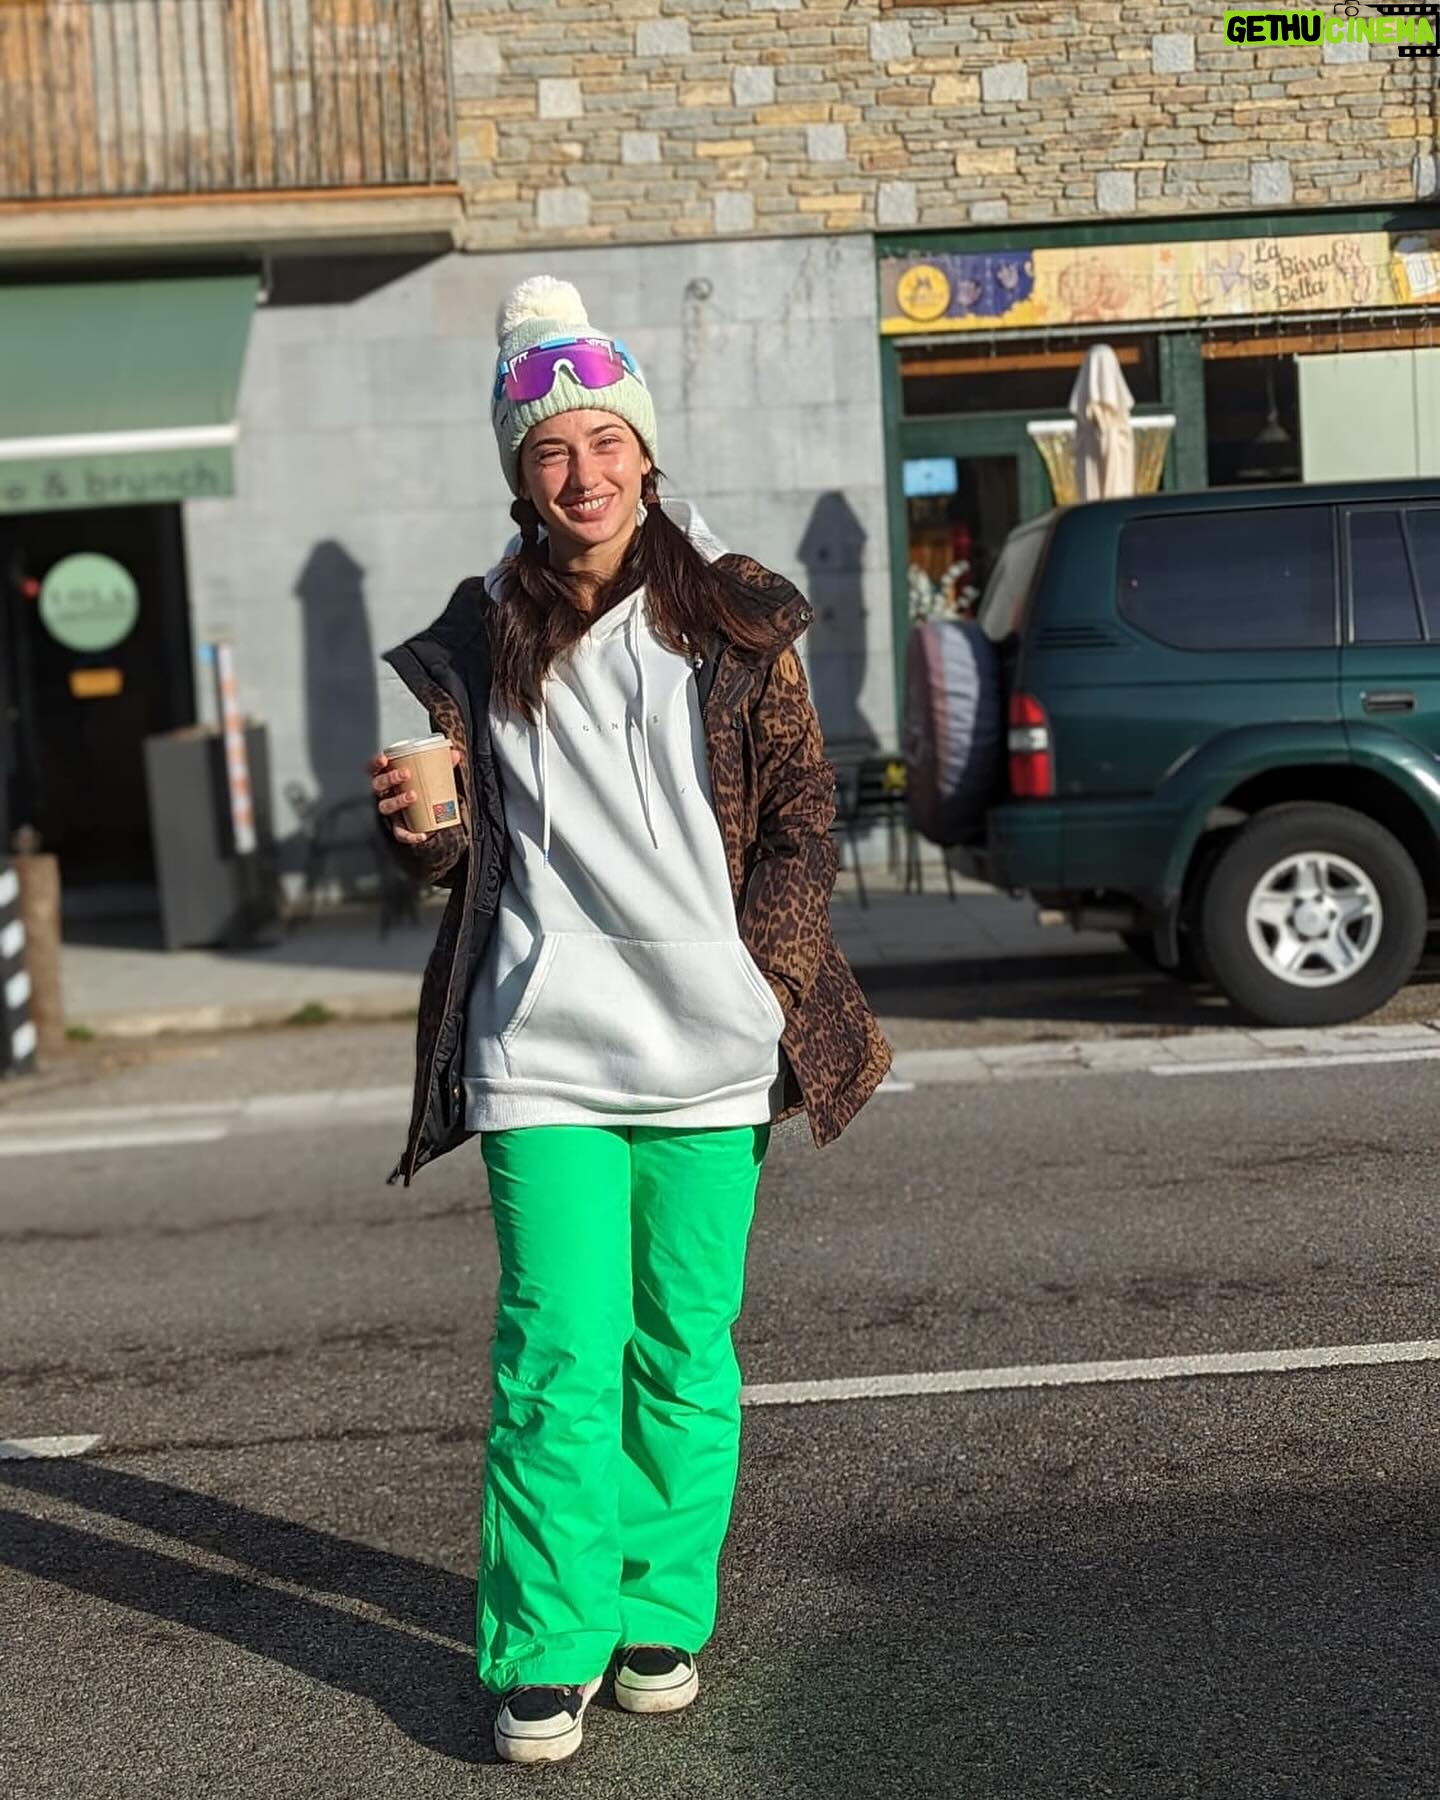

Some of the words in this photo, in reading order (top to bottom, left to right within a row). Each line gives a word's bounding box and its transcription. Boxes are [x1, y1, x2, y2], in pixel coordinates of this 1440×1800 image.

[1253, 240, 1280, 264] La
[1276, 253, 1331, 280] Birra
[1273, 276, 1327, 307] Bella
